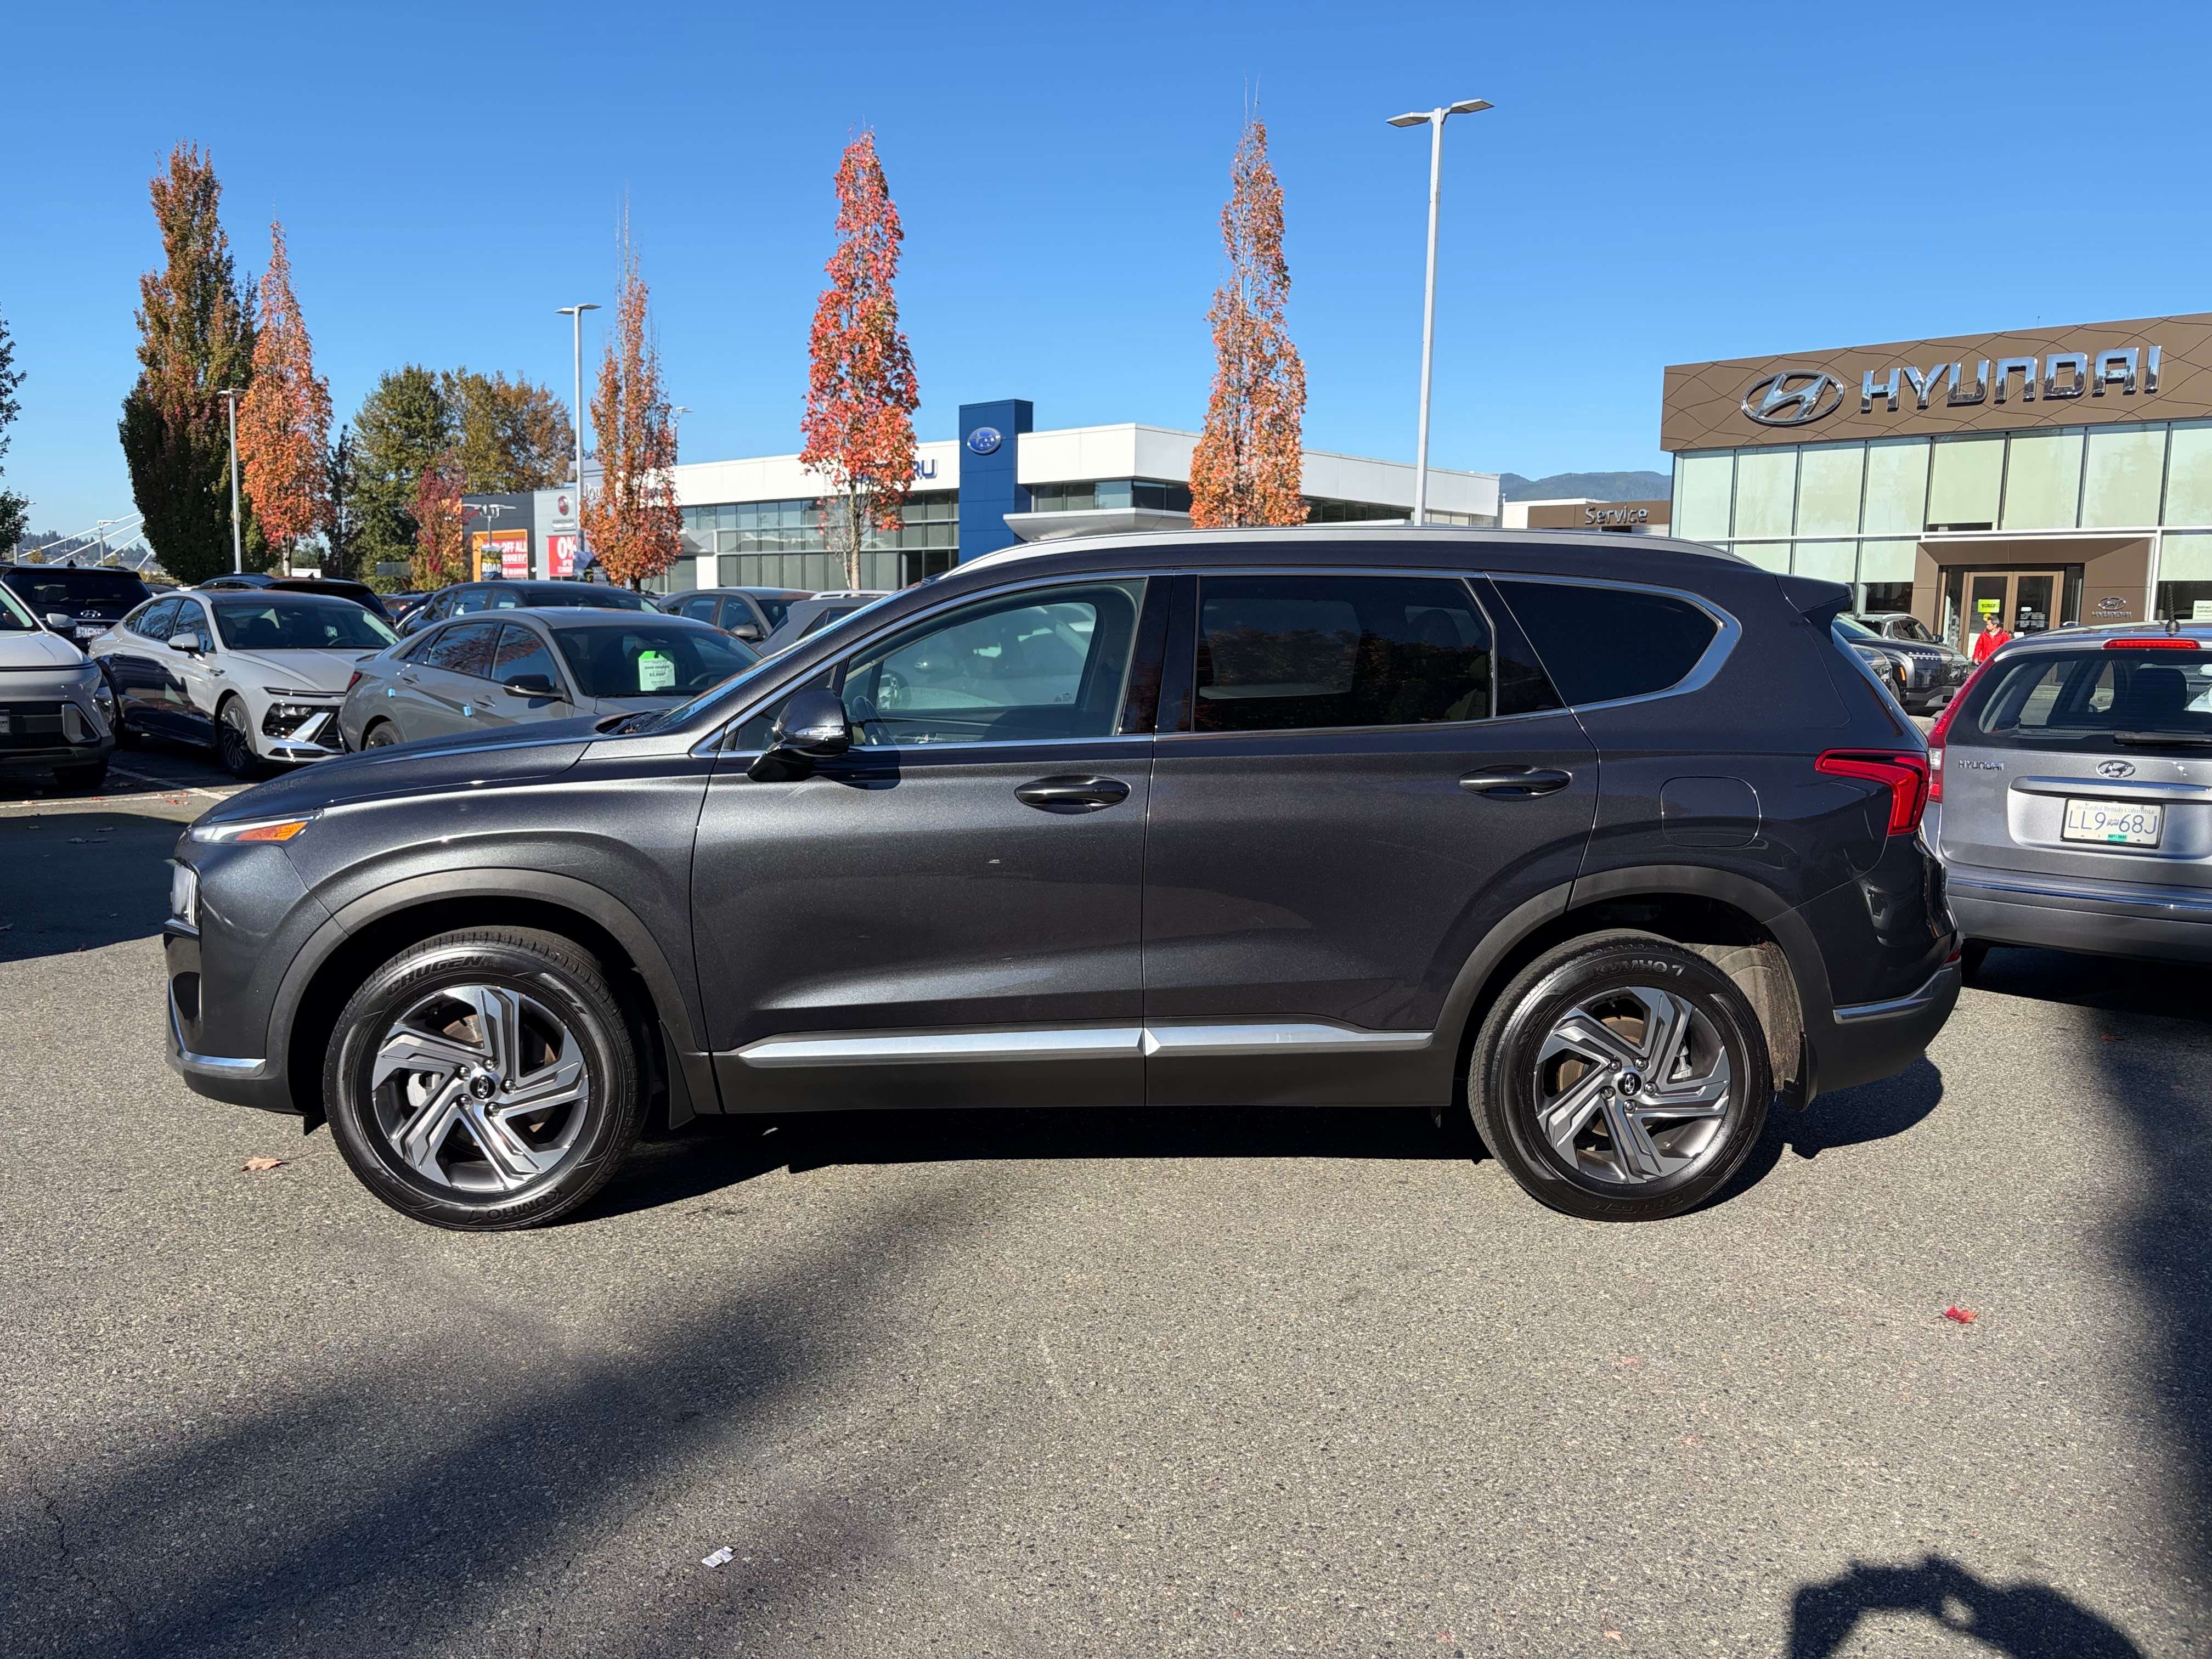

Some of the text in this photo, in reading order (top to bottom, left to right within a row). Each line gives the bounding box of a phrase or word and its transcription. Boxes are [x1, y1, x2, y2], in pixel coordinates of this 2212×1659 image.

[1860, 345, 2163, 414] HYUNDAI
[1585, 505, 1649, 524] Service
[482, 562, 501, 573] ROAD
[1959, 759, 2005, 771] HYUNDAI
[2068, 810, 2158, 834] LL9 68J
[387, 955, 485, 997] CRUGEN
[1593, 960, 1668, 978] KUMHO
[486, 1186, 565, 1221] KUMHO
